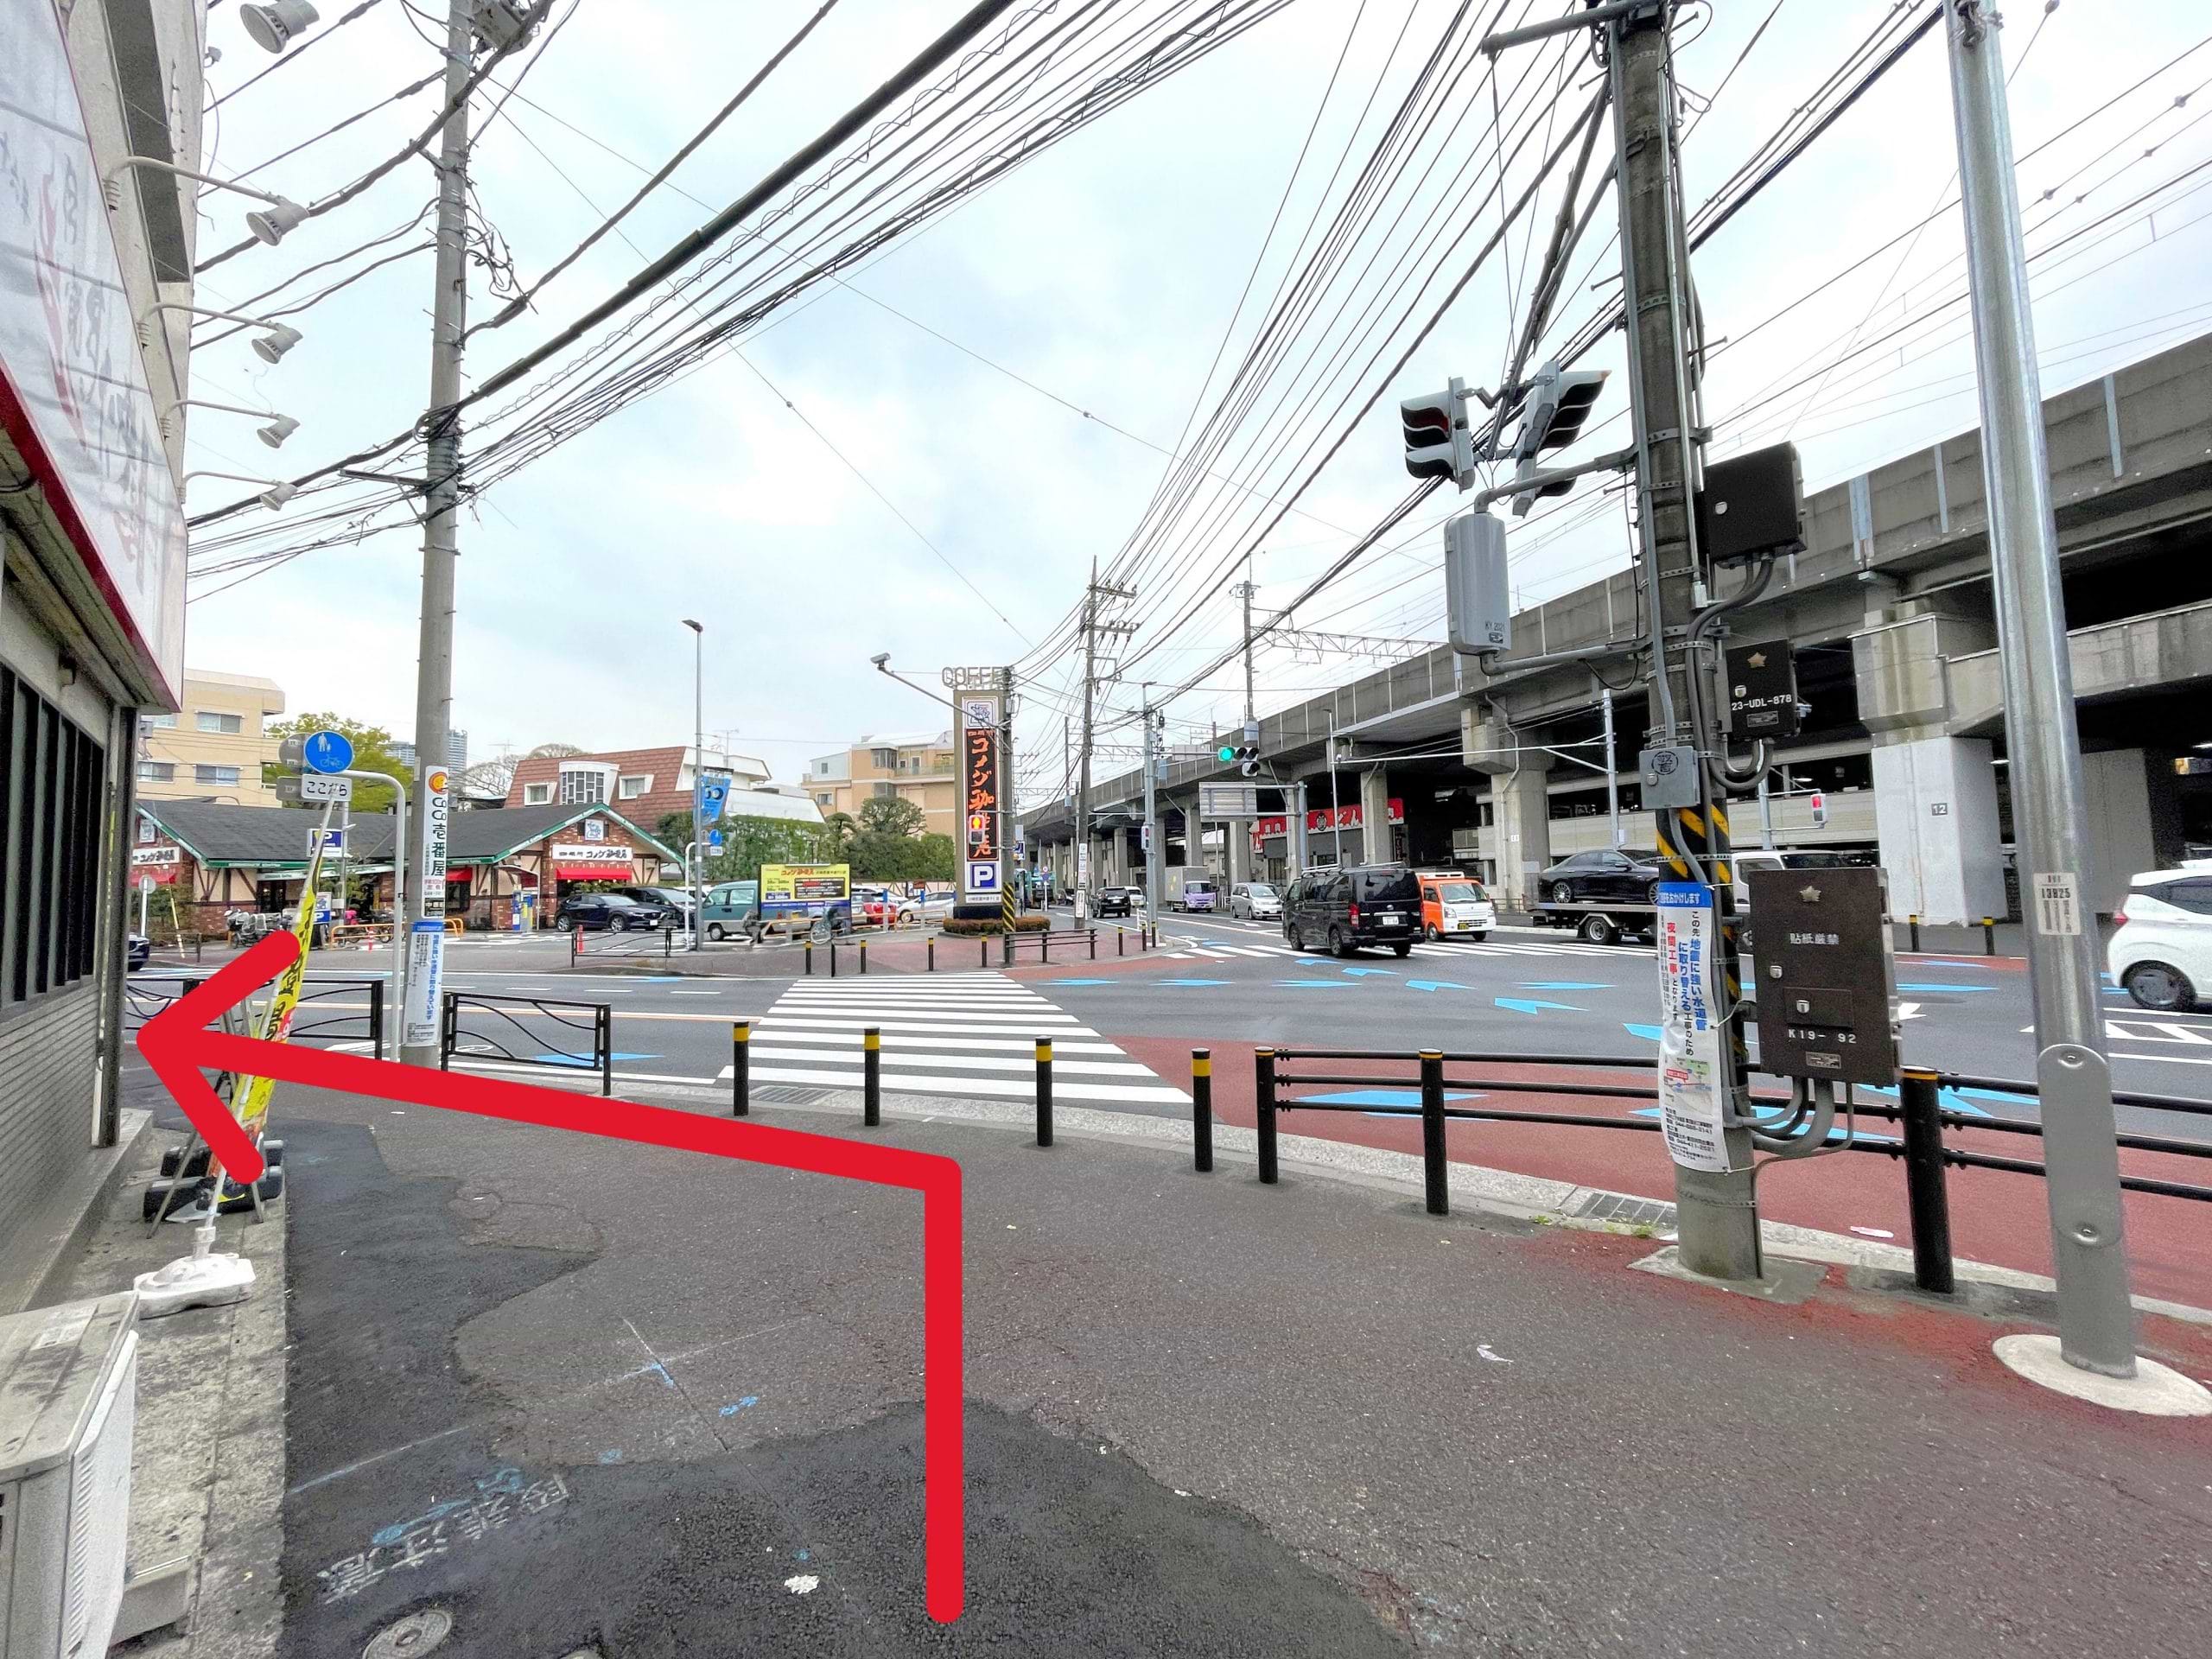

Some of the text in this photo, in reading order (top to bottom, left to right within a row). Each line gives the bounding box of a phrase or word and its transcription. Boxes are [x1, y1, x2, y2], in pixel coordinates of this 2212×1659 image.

[942, 667, 1014, 685] COFFE
[1732, 694, 1792, 710] 23-UDL-878
[307, 781, 347, 797] ここから
[1933, 804, 1947, 814] 12
[1789, 932, 1840, 945] 貼紙厳禁
[1838, 1033, 1856, 1044] 92
